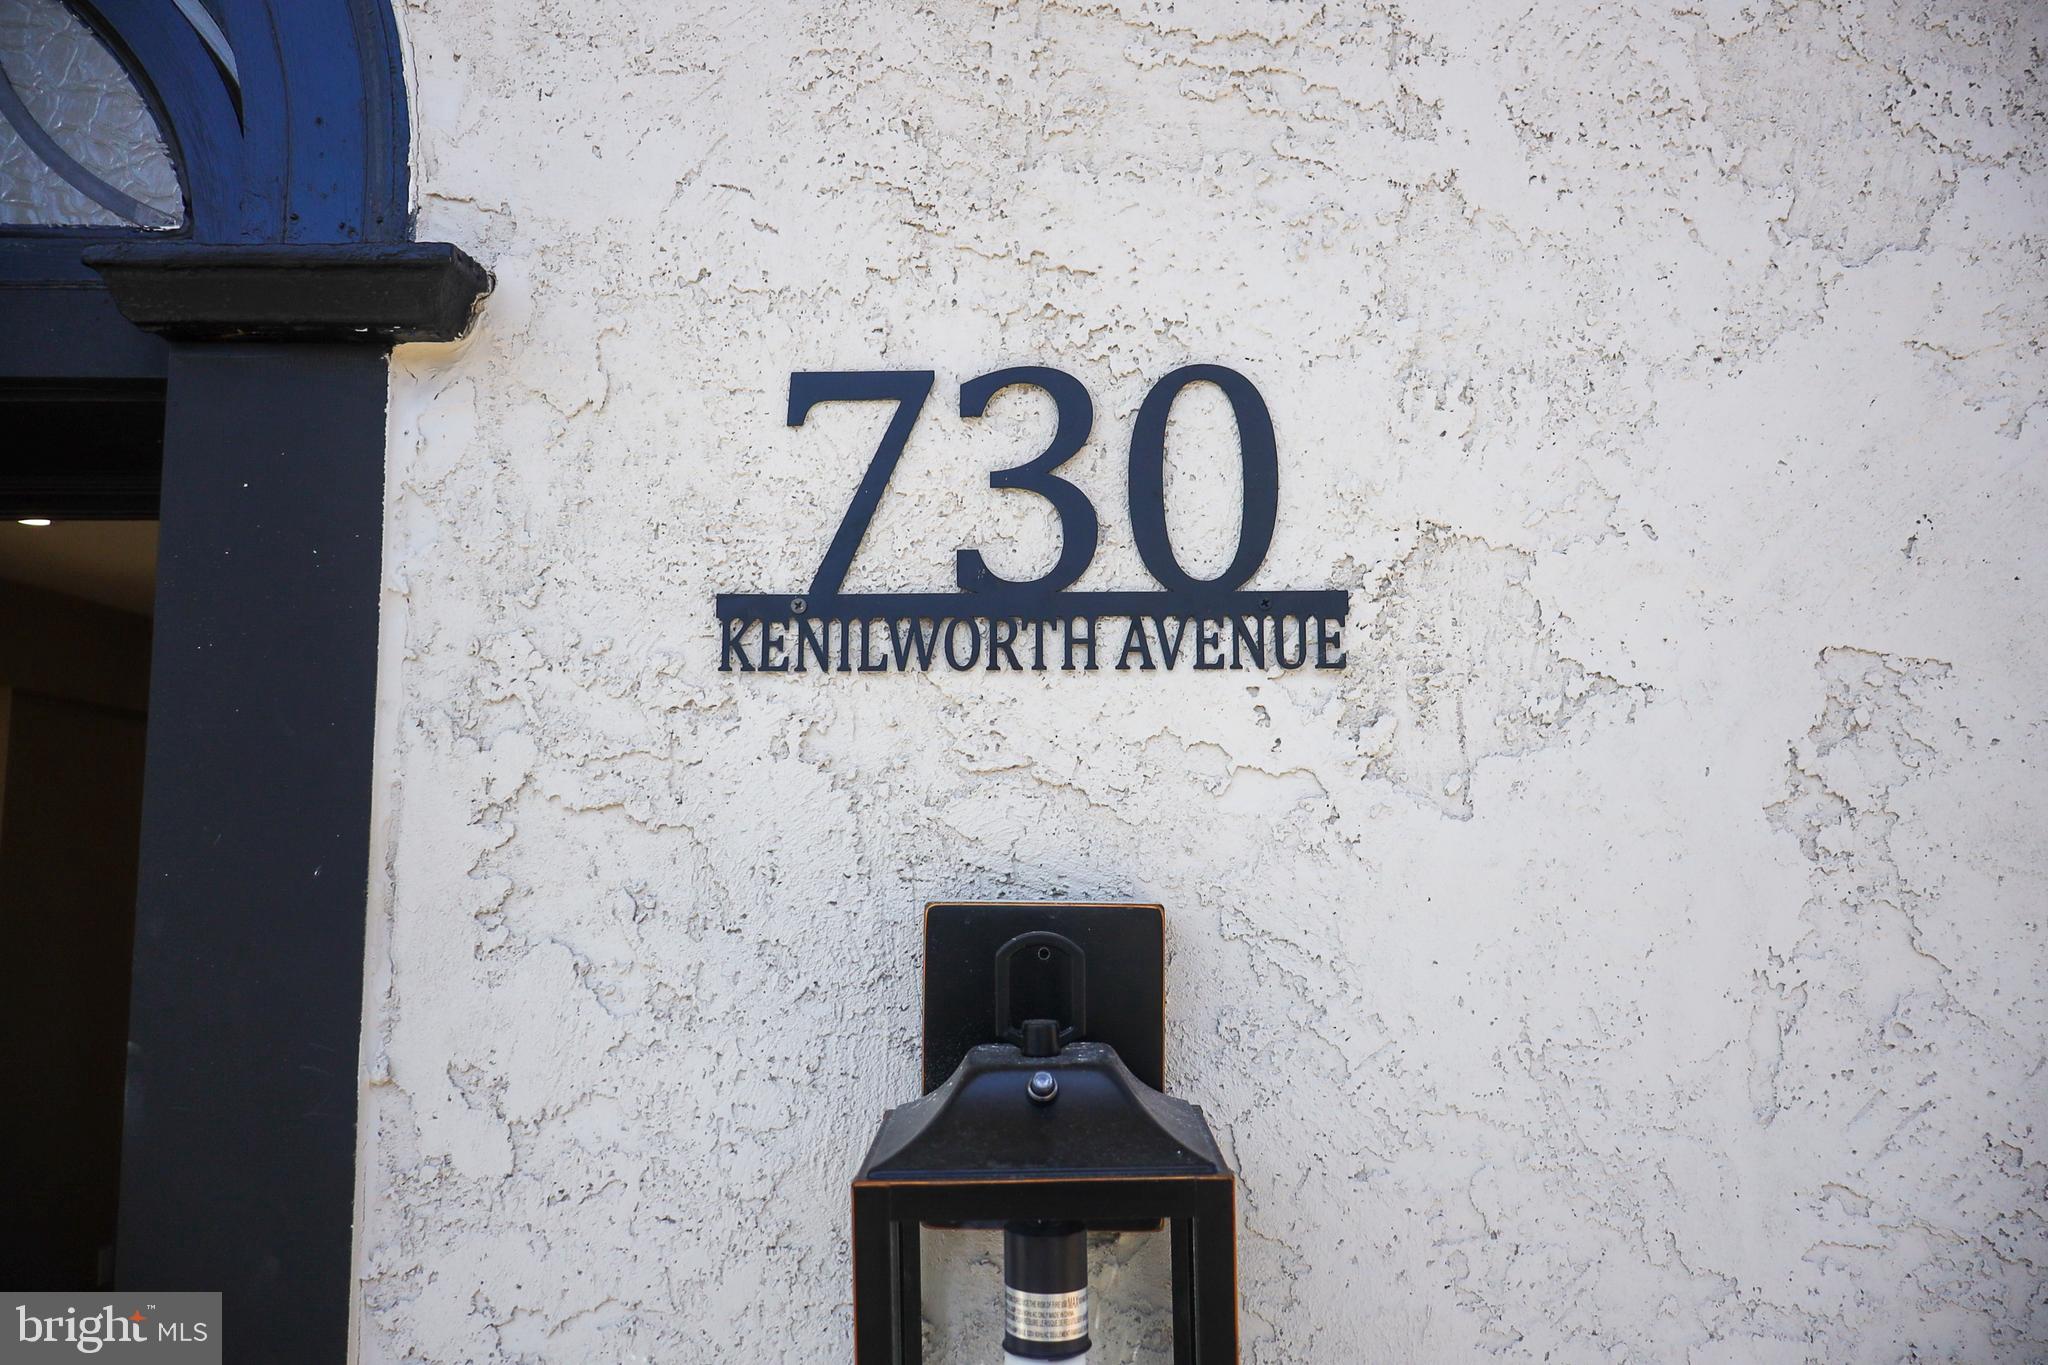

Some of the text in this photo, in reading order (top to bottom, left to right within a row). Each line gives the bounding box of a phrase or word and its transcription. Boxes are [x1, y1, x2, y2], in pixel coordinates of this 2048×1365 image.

[786, 363, 1279, 598] 730
[718, 613, 1347, 672] KENILWORTH AVENUE
